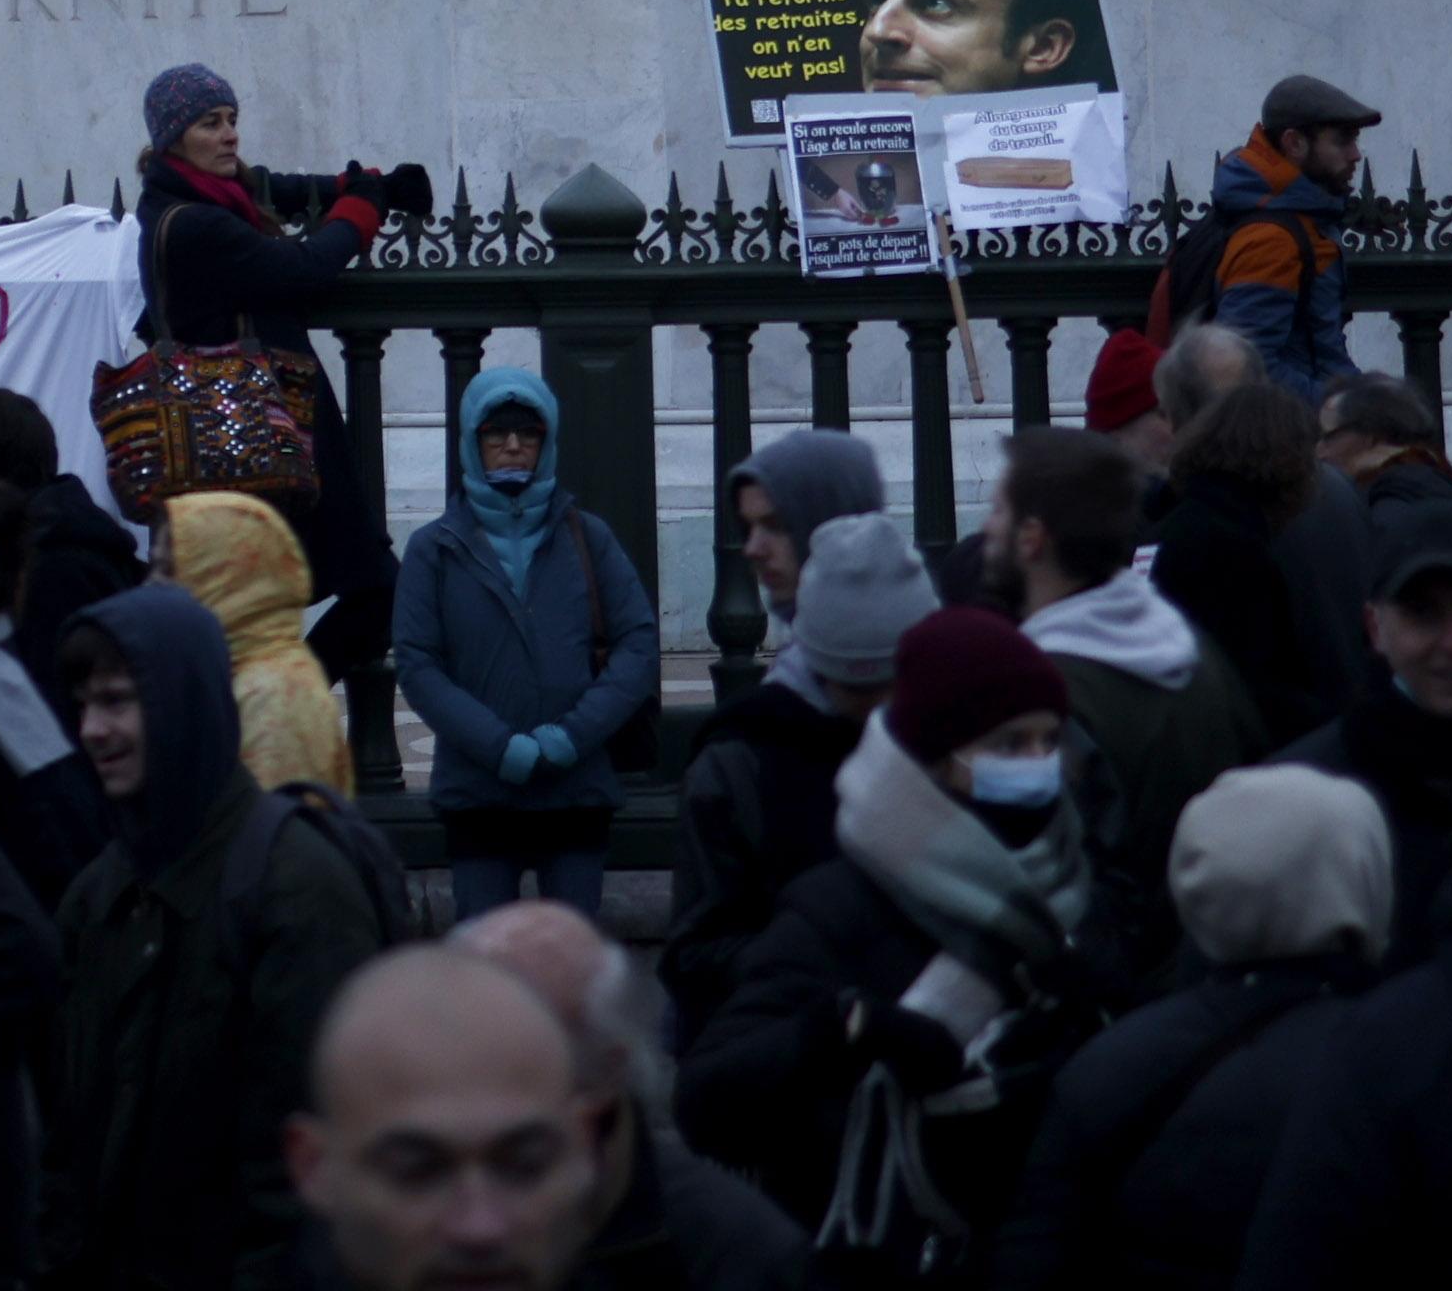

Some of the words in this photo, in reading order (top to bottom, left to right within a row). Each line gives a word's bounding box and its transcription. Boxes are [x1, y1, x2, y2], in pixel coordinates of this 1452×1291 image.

[755, 9, 866, 30] retraites,
[752, 41, 778, 55] on
[787, 34, 831, 53] n'en
[744, 60, 793, 79] veut
[802, 55, 846, 81] pas!
[794, 123, 807, 138] Si
[811, 127, 826, 137] on
[829, 121, 867, 135] recule
[870, 122, 912, 133] encore
[1010, 121, 1057, 135] temps
[832, 138, 846, 150] de
[850, 137, 861, 150] la
[864, 136, 909, 149] retraite
[808, 239, 829, 252] Les
[865, 236, 877, 248] de
[807, 252, 854, 268] risquent
[856, 249, 870, 262] de
[873, 247, 917, 264] changer
